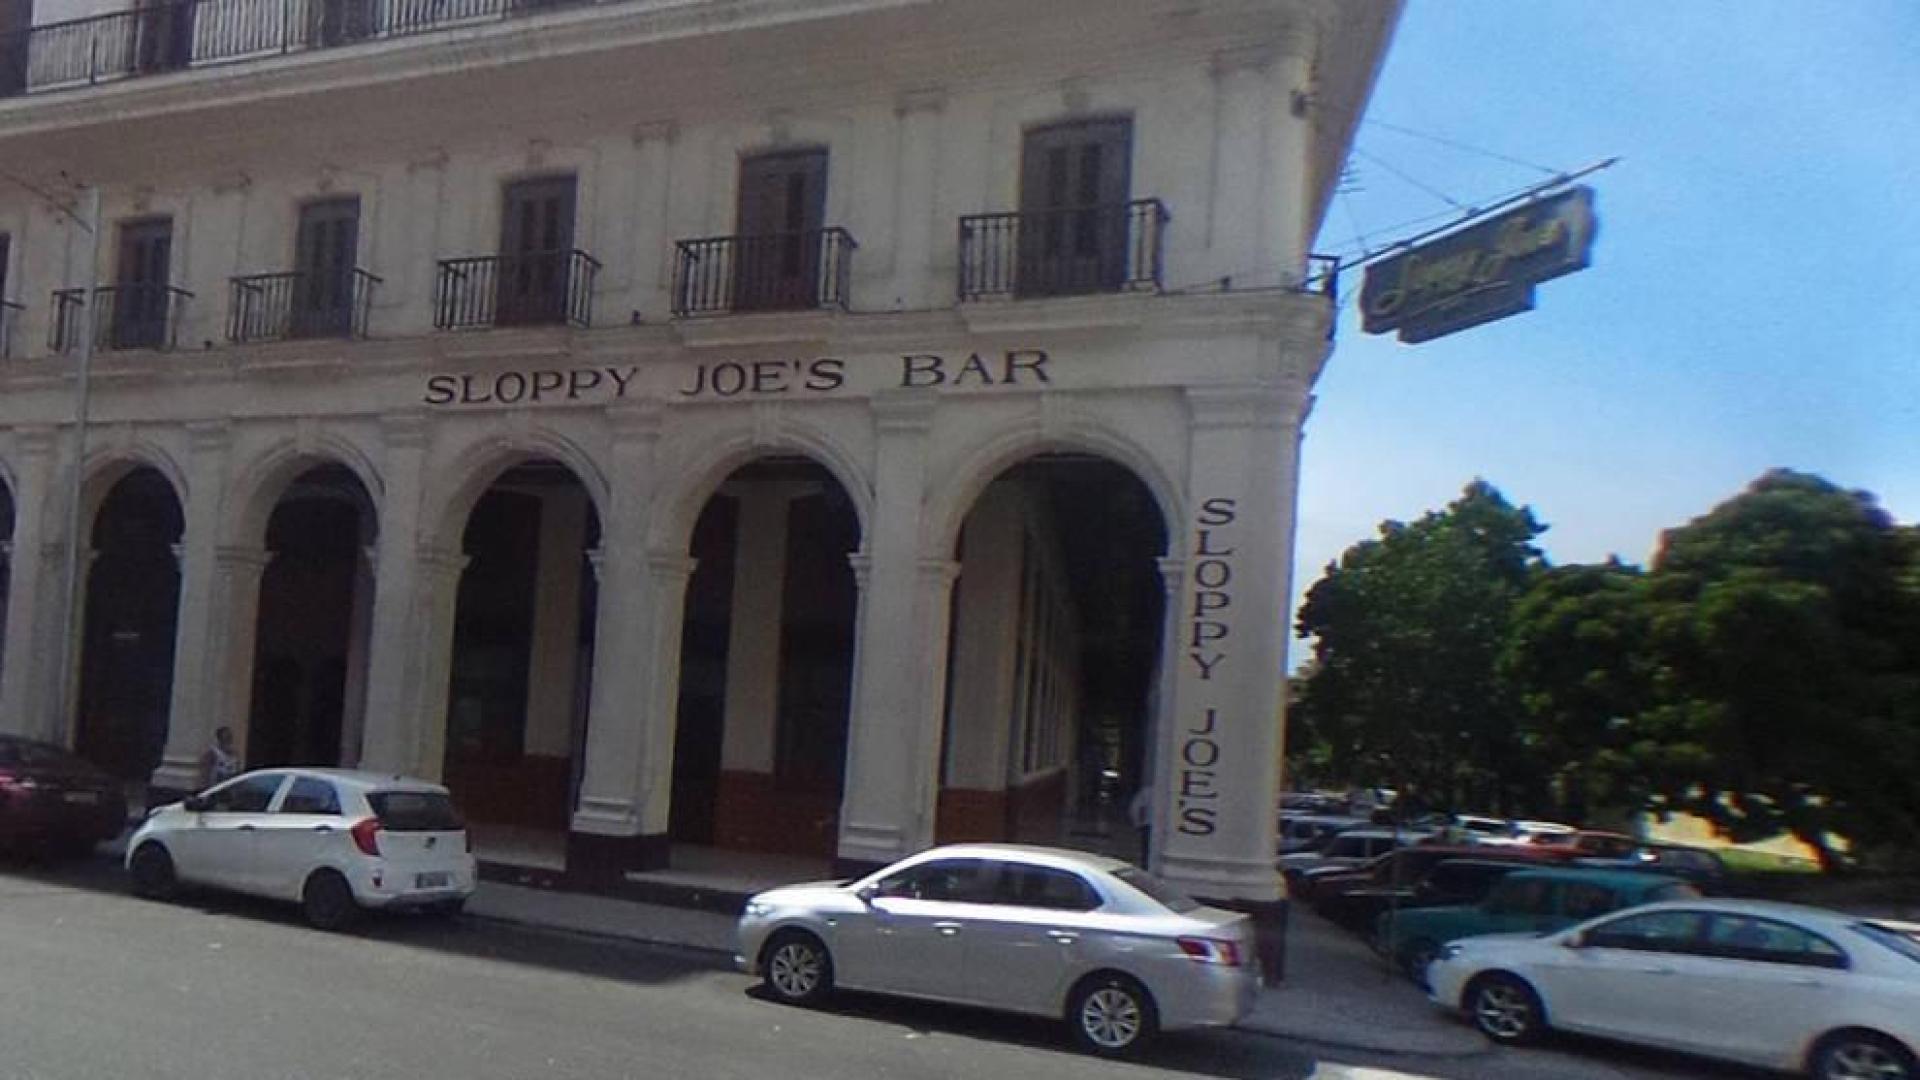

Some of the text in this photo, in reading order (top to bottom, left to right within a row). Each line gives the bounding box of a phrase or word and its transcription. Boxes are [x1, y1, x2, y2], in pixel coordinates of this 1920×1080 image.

[424, 350, 1050, 404] SLOPPY JOE'S BAR
[1178, 498, 1236, 836] SLOPPY JOE'S
